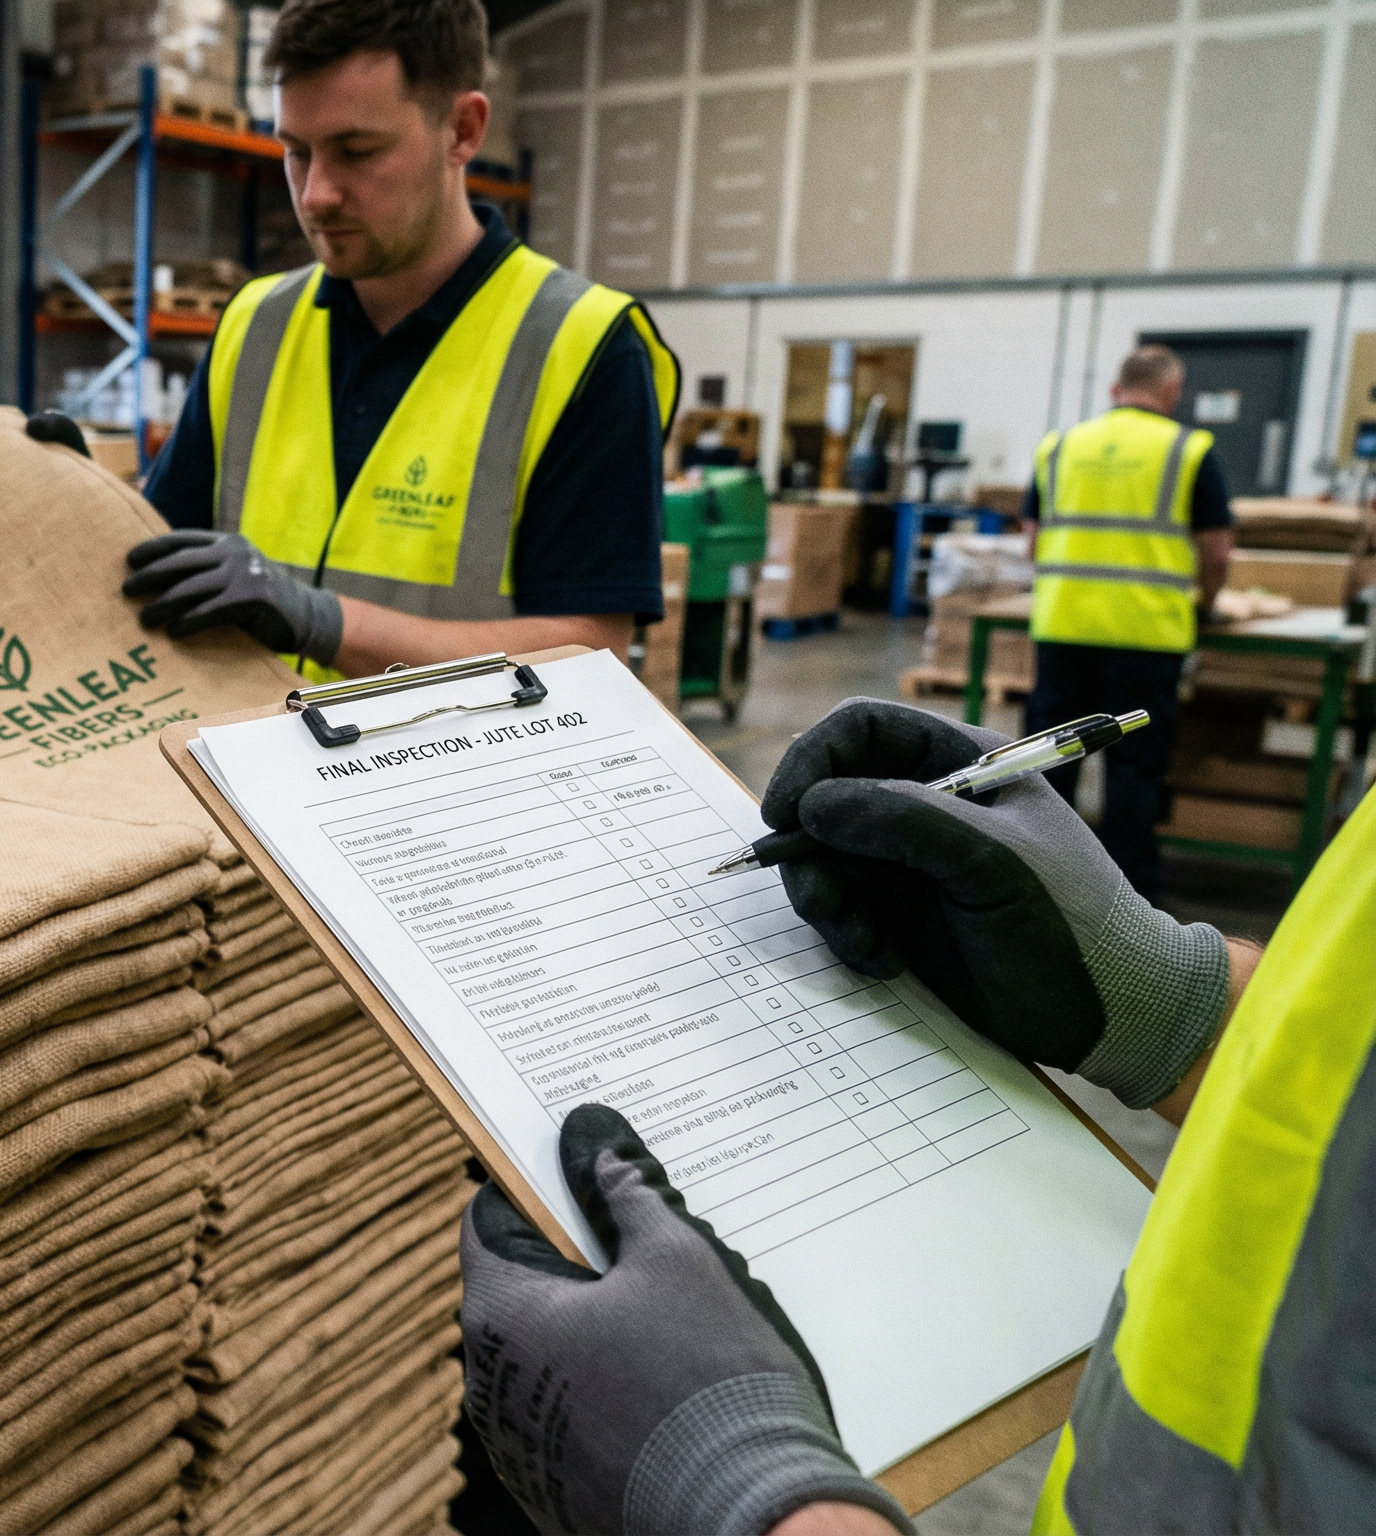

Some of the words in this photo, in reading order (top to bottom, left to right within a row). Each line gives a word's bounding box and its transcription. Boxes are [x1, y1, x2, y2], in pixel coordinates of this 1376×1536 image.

[29, 703, 144, 750] FIBERS
[316, 757, 373, 781] FINAL
[369, 736, 473, 769] INSPECTION
[485, 723, 524, 745] JUTE
[521, 717, 555, 735] LOT
[557, 711, 588, 729] 402
